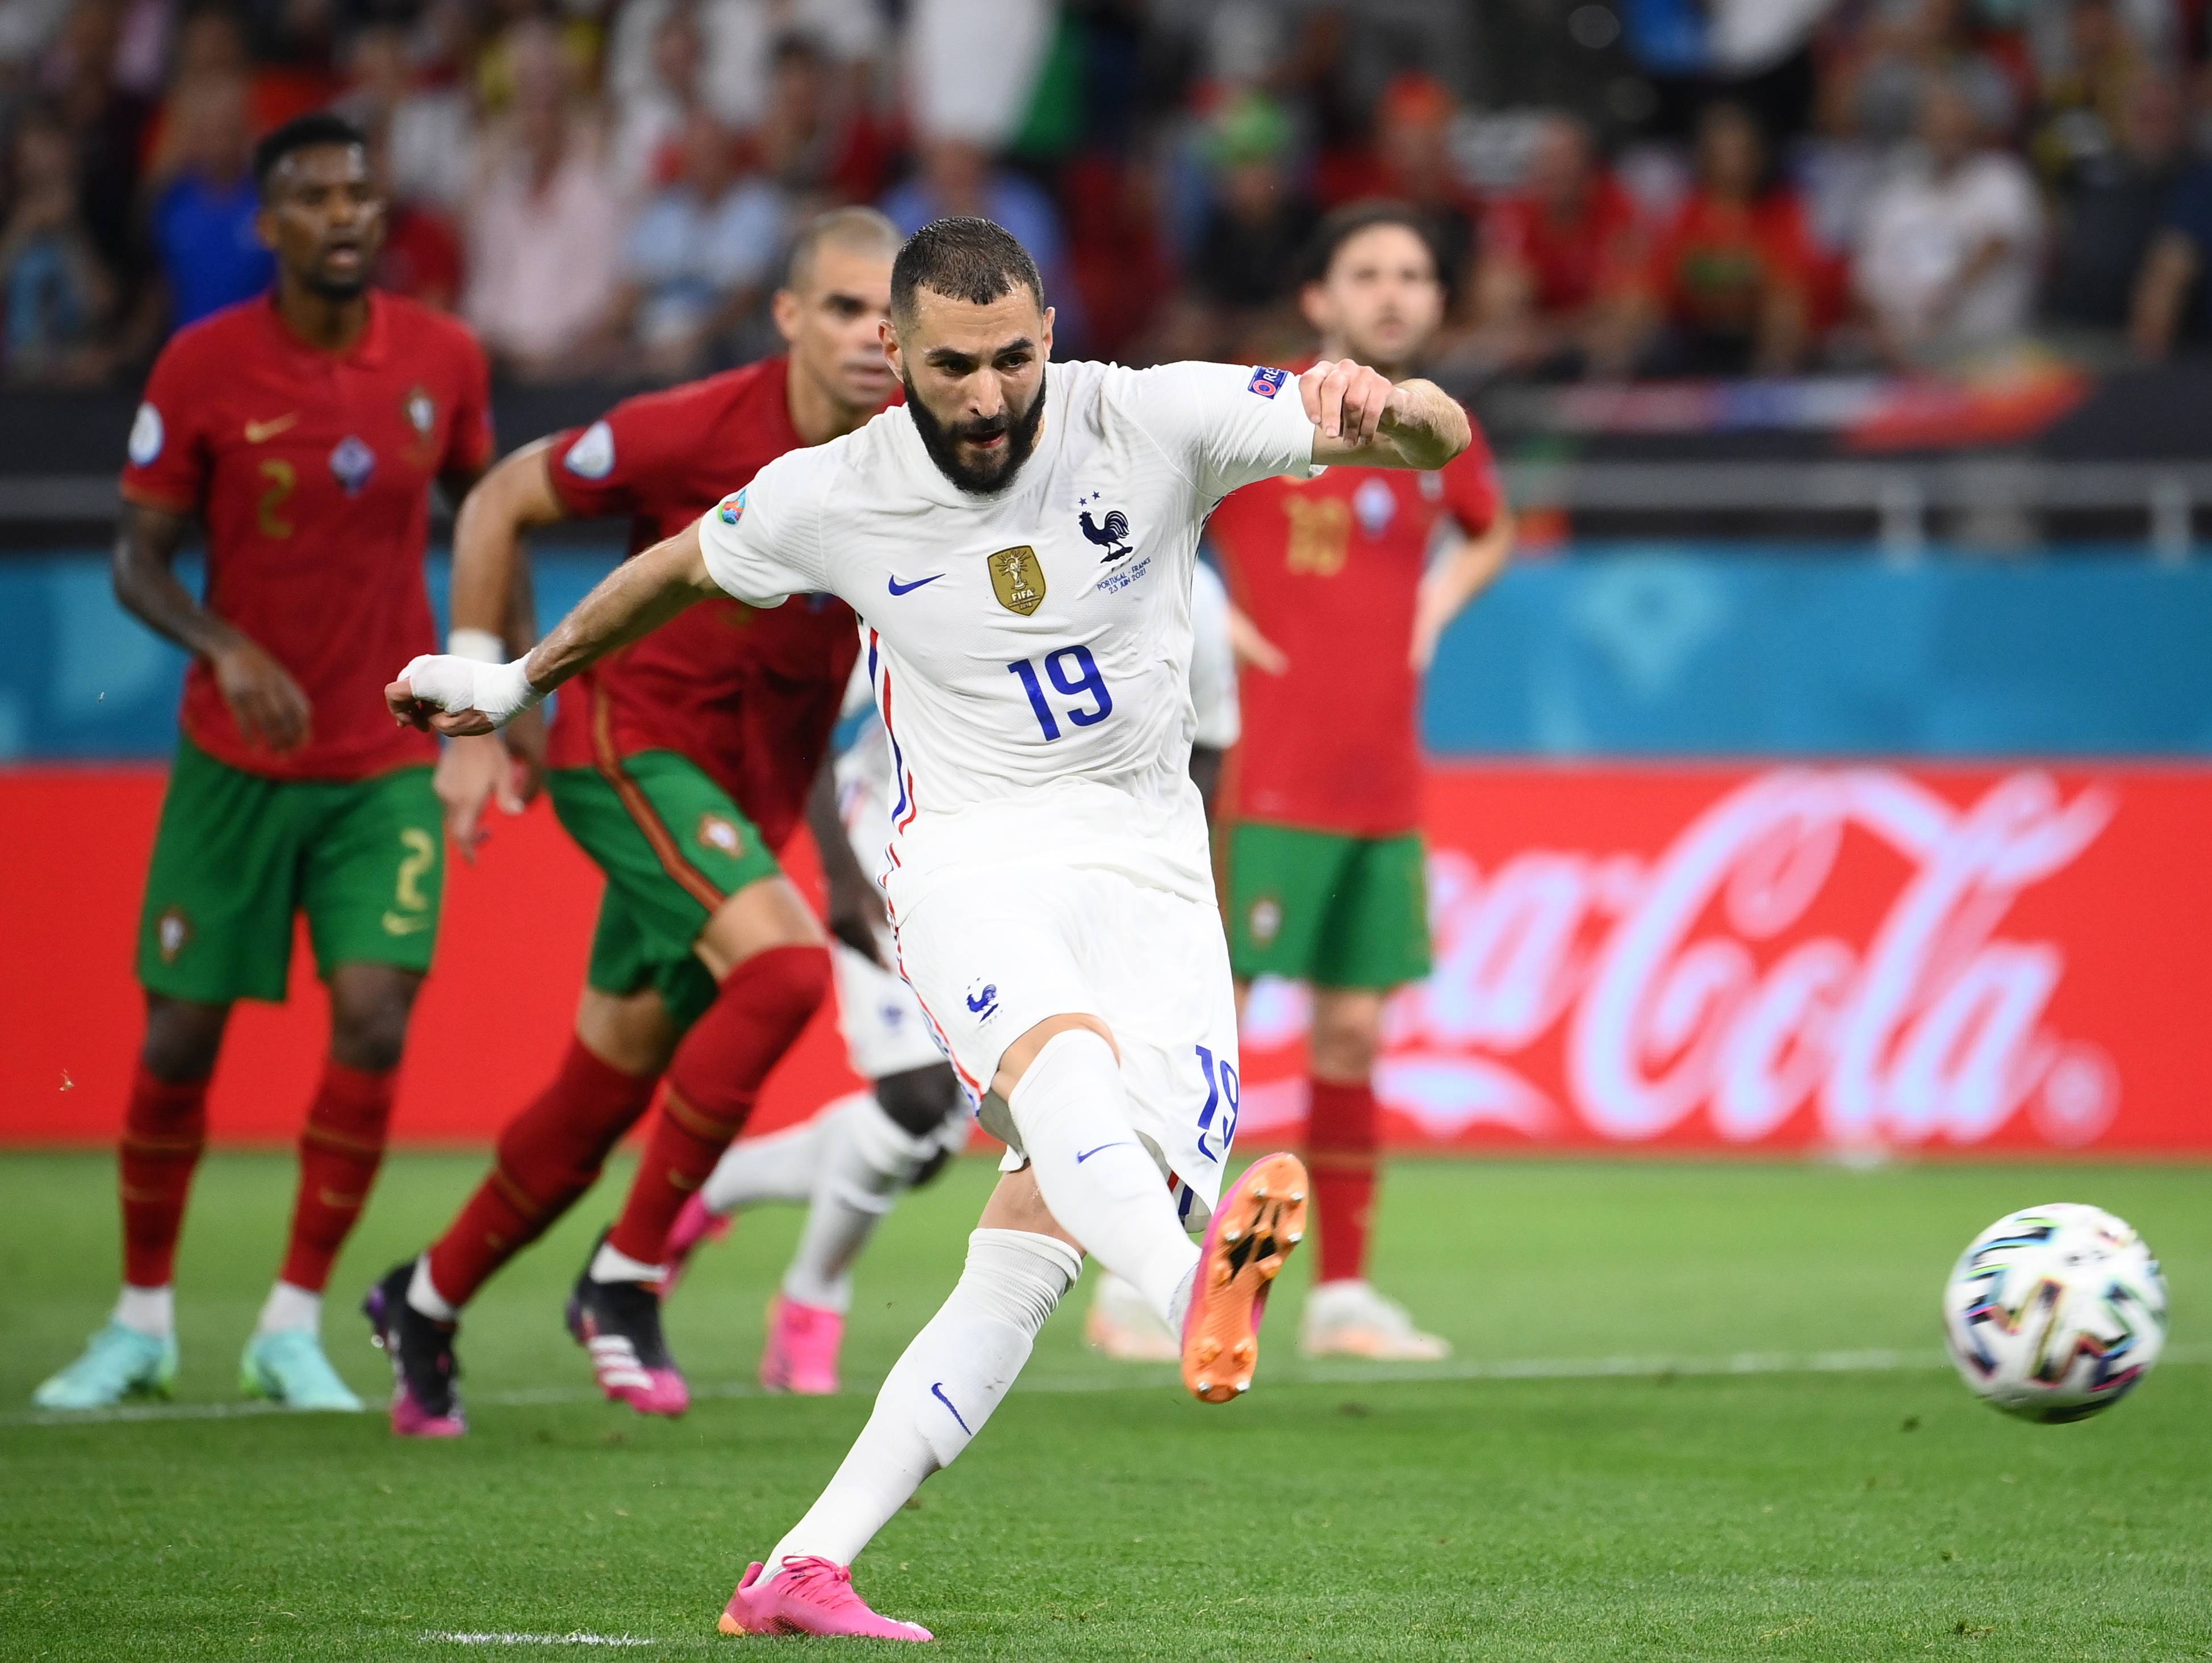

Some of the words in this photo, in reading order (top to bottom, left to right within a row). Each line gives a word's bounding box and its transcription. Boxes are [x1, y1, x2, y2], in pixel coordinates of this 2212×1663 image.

[257, 458, 297, 540] 2
[1011, 589, 1034, 601] FIFA
[1097, 571, 1127, 591] PORTUGAL
[1109, 584, 1118, 594] 23
[1131, 568, 1147, 581] 2021
[1007, 645, 1113, 741] 19
[397, 827, 436, 910] 2
[1195, 1044, 1239, 1150] 19
